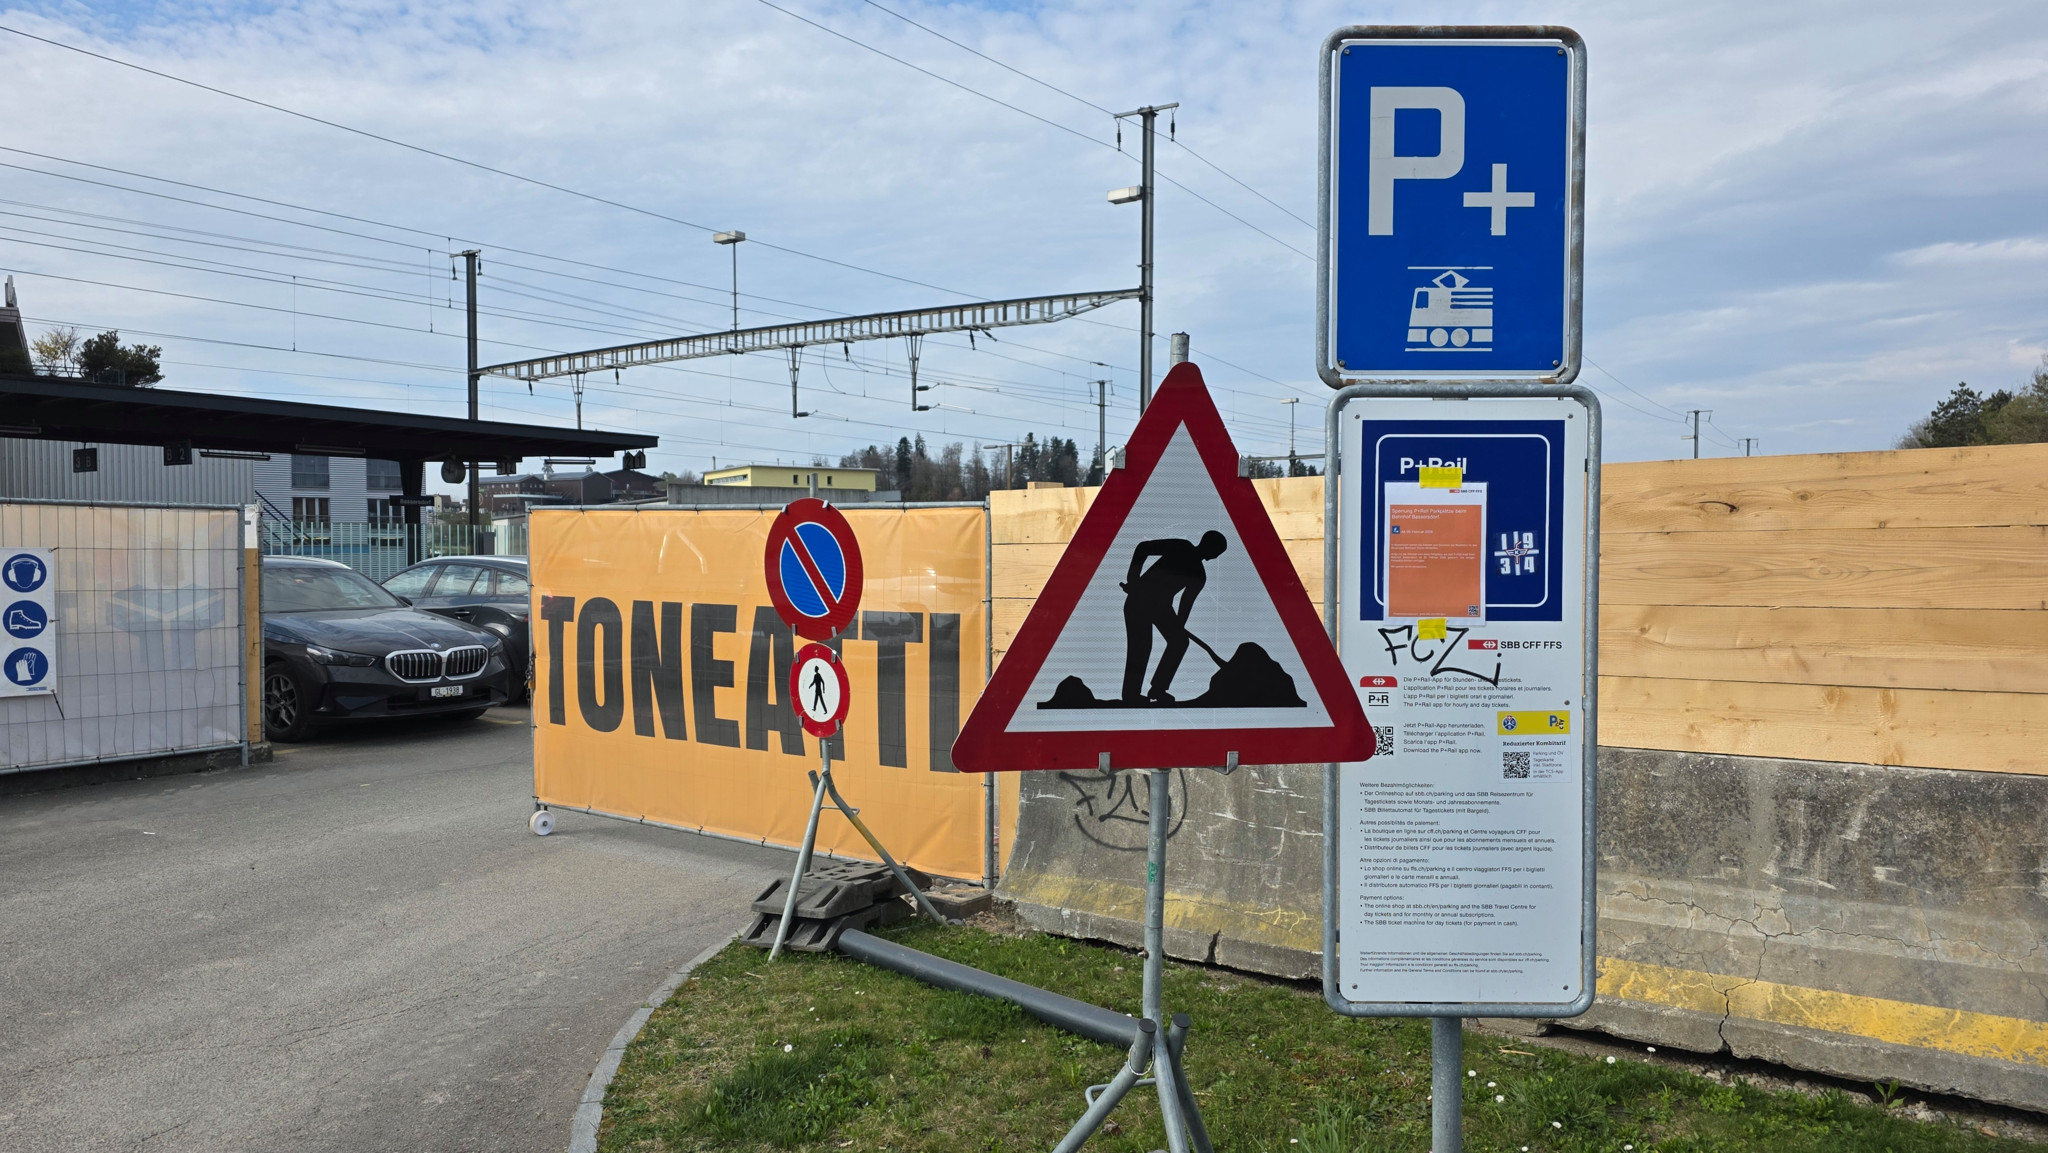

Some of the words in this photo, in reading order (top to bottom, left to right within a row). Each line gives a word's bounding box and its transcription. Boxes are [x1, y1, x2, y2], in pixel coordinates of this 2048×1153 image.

[180, 450, 185, 460] 2
[1500, 641, 1520, 649] SBB
[1522, 641, 1541, 649] CFF
[1544, 641, 1562, 649] FFS
[1368, 695, 1389, 704] P+R
